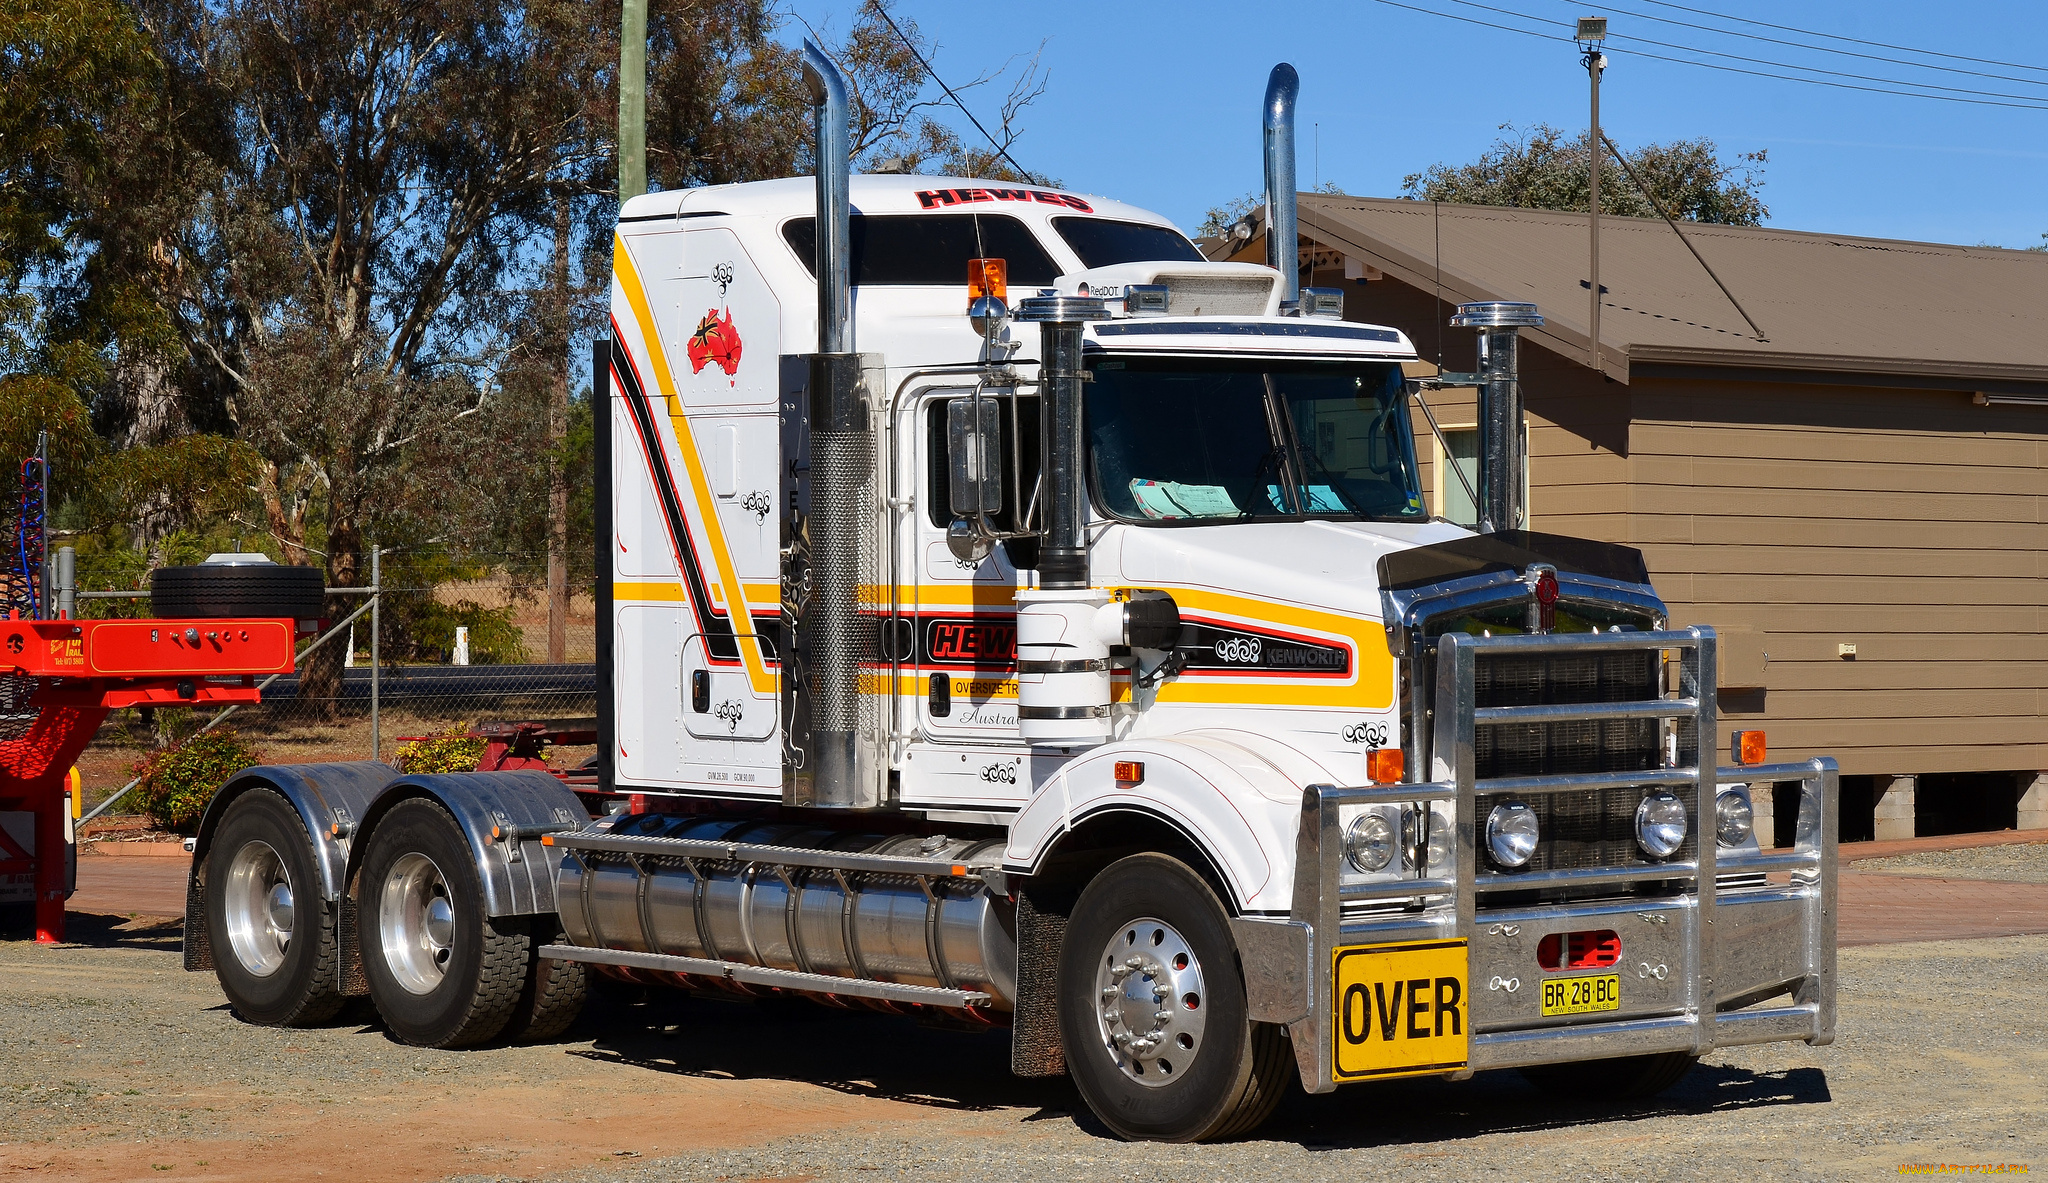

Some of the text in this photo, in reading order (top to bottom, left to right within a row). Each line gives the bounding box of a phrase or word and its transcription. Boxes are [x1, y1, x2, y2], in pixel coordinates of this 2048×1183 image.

[914, 188, 1094, 214] HEWES
[1090, 285, 1119, 297] RedDOT
[933, 624, 1018, 659] HEW
[1266, 647, 1346, 666] KENWORTH
[956, 682, 1004, 695] OVERSIZE
[1342, 976, 1462, 1045] OVER
[1551, 1006, 1565, 1014] NEW
[1567, 1005, 1588, 1013] SOUTH
